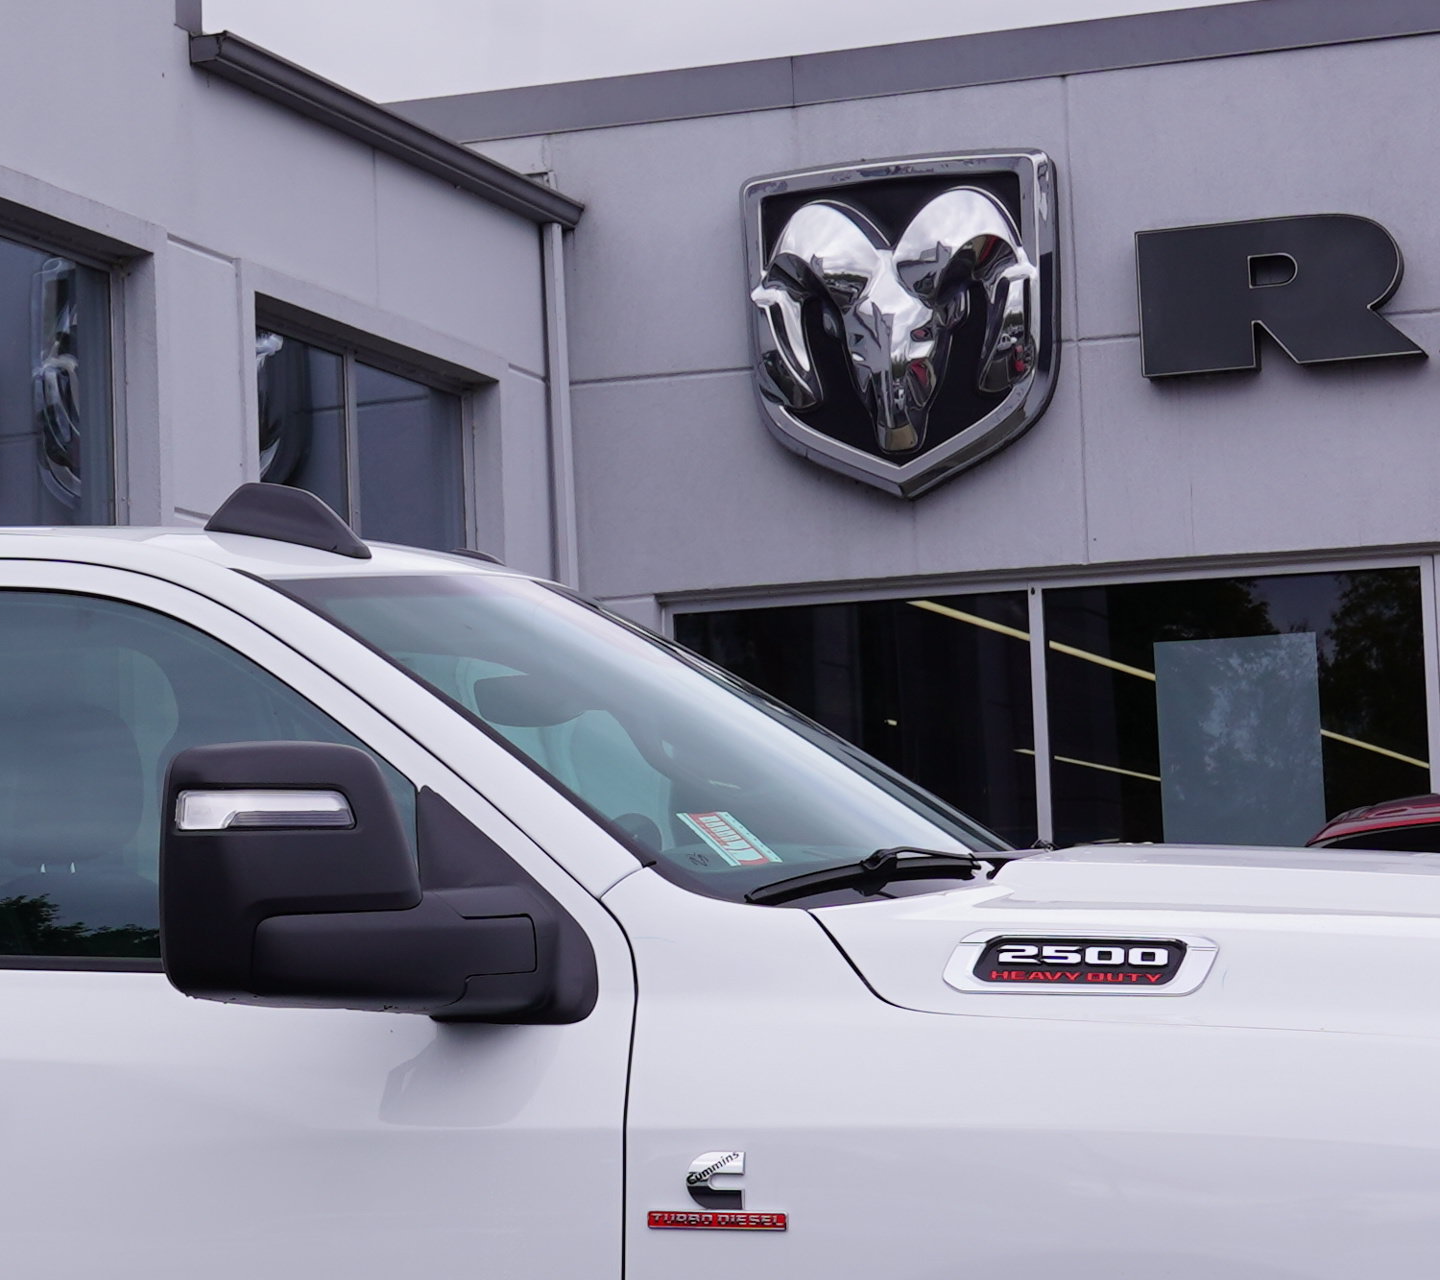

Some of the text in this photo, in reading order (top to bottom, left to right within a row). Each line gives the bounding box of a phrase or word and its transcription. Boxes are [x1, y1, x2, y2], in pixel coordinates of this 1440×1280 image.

[997, 944, 1169, 967] 2500
[991, 969, 1162, 984] HEAVY DUTY
[686, 1151, 740, 1186] Cummins
[651, 1213, 787, 1226] TURBO DIESEL
